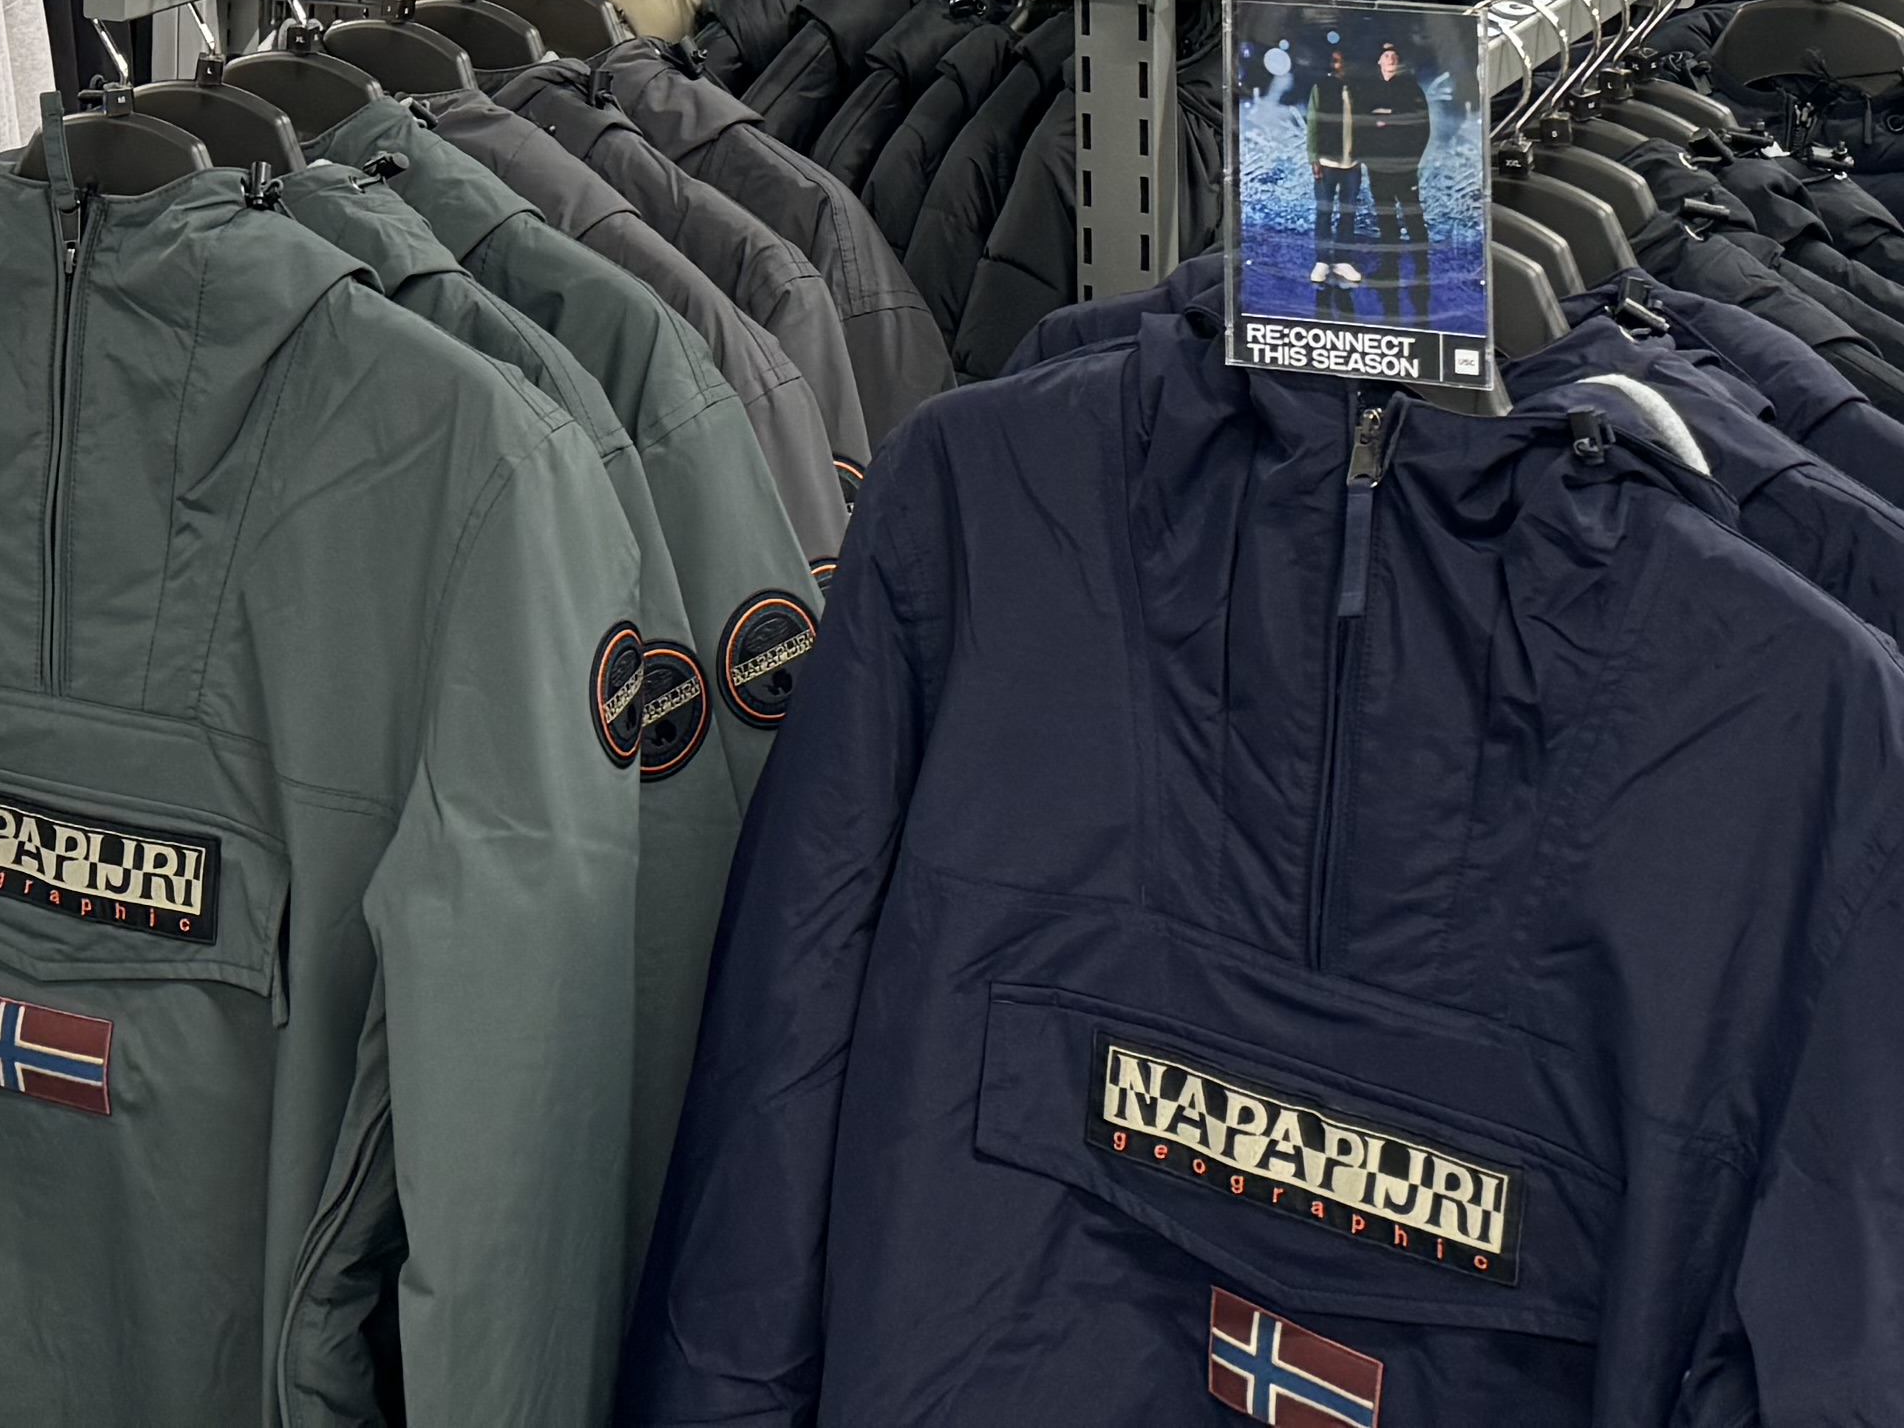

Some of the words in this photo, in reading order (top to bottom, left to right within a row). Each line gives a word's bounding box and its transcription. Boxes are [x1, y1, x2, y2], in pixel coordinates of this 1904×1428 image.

[1246, 323, 1415, 356] RE:CONNECT
[1246, 343, 1307, 367] THIS
[1311, 348, 1419, 379] SEASON
[1109, 1049, 1507, 1250] NAPAPIJRI
[1112, 1129, 1488, 1270] geographic
